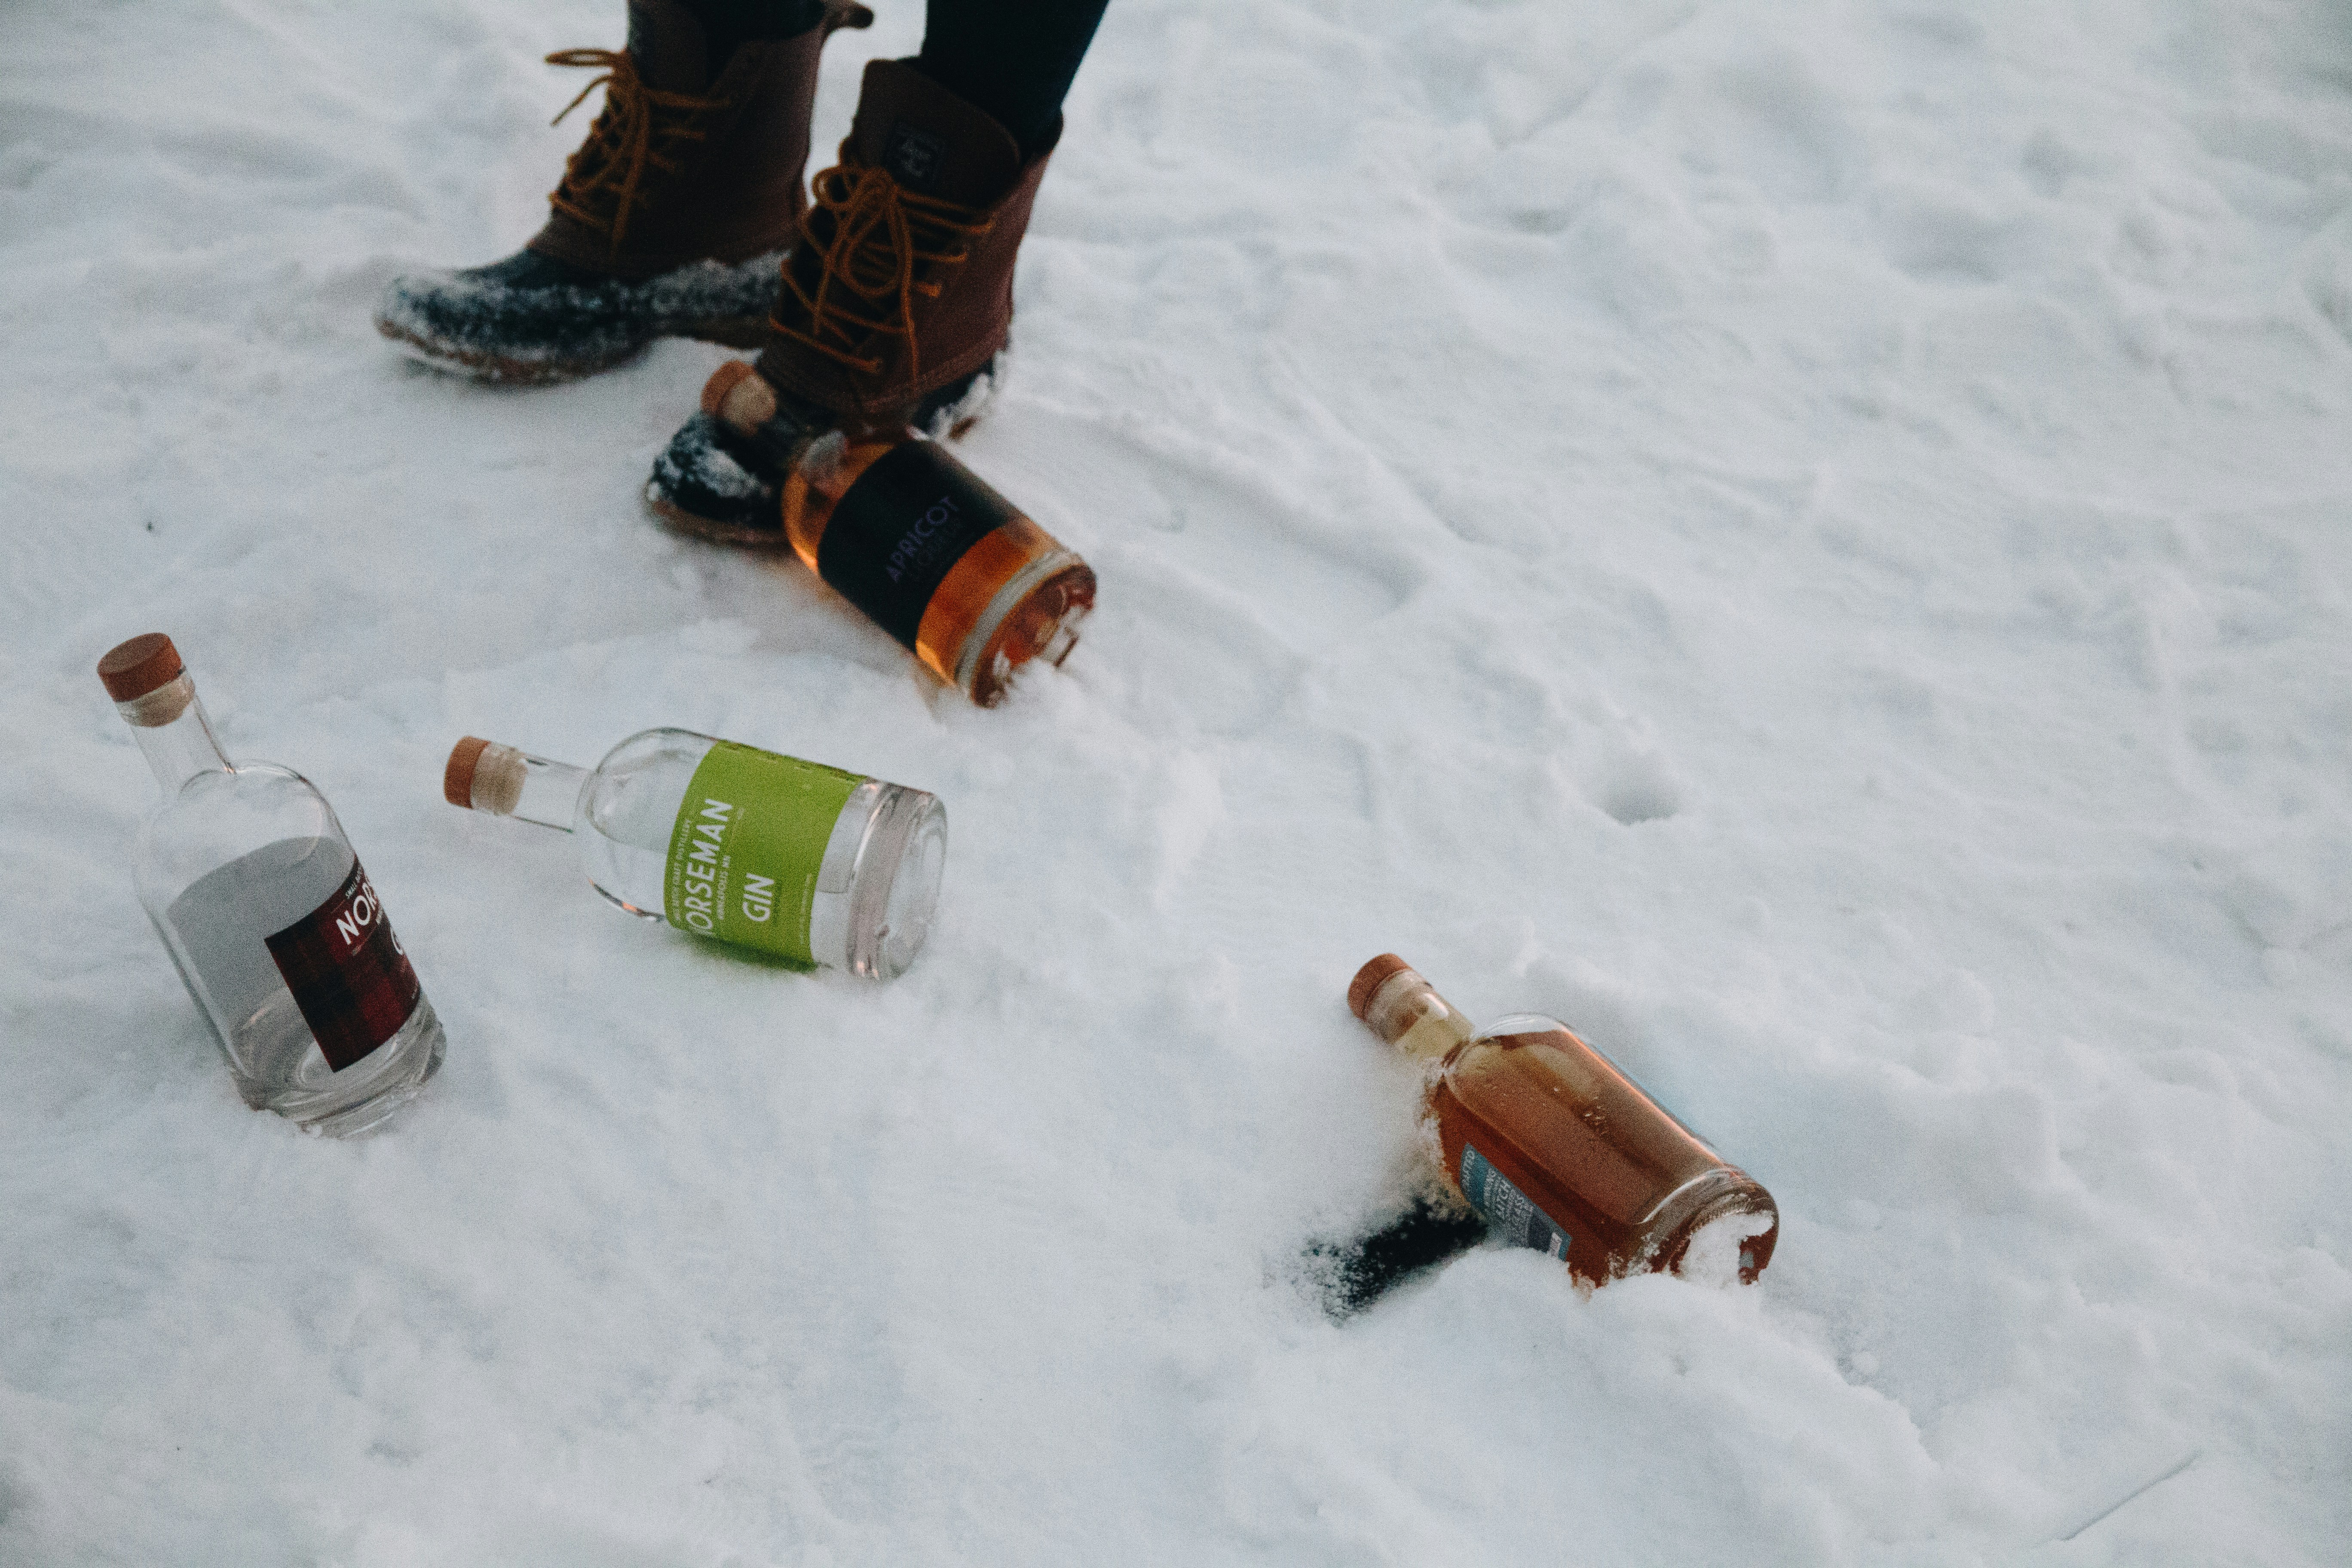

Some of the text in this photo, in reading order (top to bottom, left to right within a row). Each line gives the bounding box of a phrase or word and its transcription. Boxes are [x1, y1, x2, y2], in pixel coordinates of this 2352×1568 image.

[886, 496, 959, 583] APRICOT
[336, 875, 377, 945] NOR
[743, 874, 775, 922] GIN
